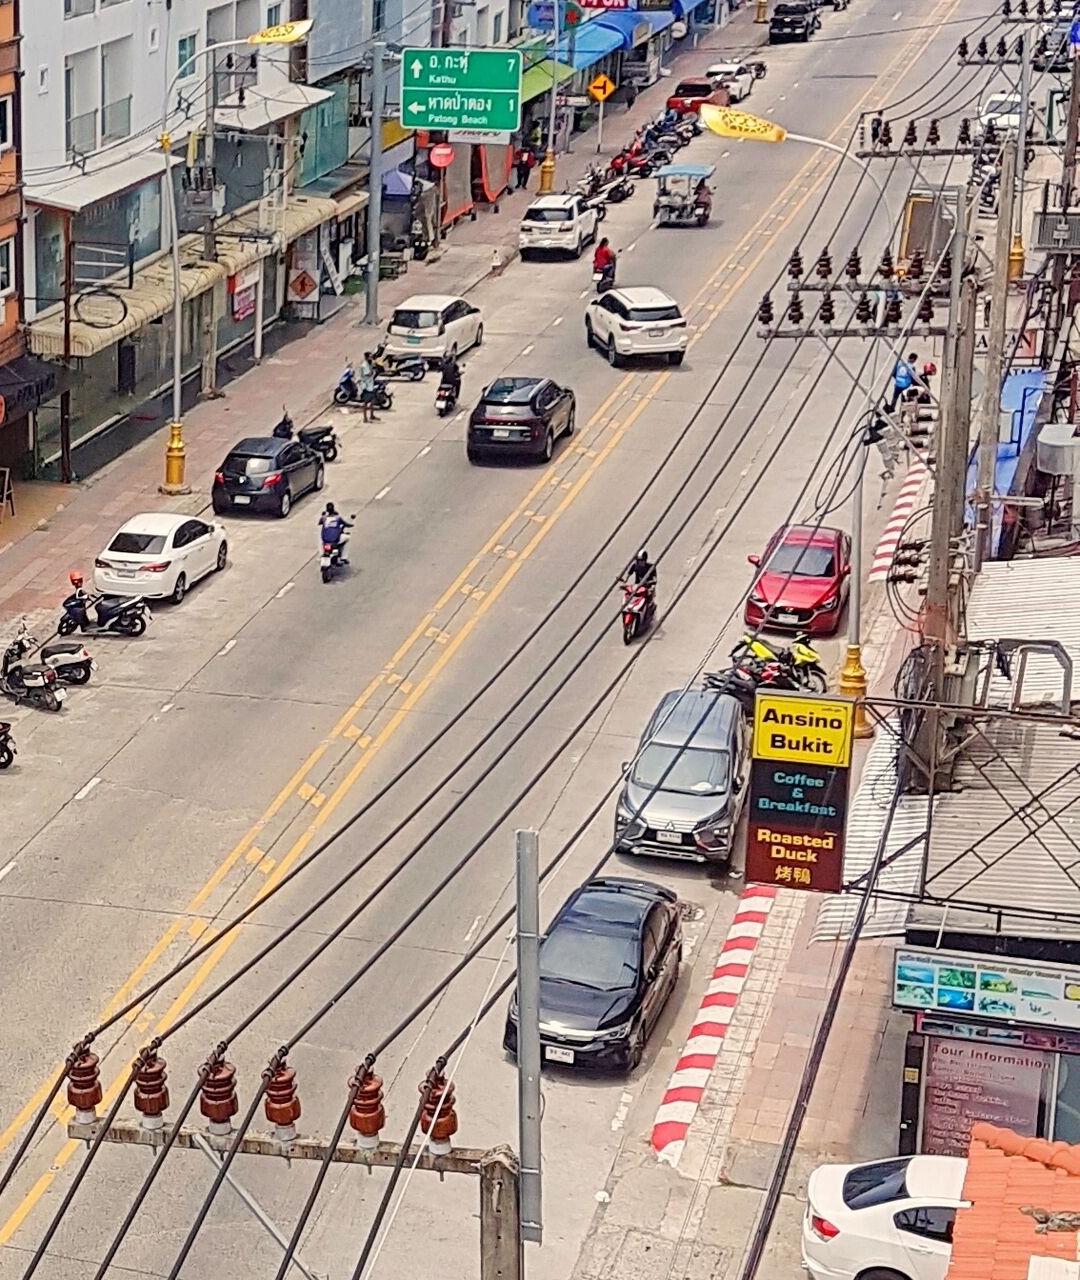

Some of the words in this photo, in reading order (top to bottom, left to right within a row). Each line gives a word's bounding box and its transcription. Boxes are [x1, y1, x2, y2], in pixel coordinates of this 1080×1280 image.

[507, 59, 516, 72] 7
[428, 74, 457, 84] Kathu
[428, 91, 492, 112] หาดป่าตอง
[508, 99, 515, 112] 1
[428, 114, 458, 125] Patong
[461, 115, 488, 125] Beach
[762, 708, 844, 730] Ansino
[770, 733, 834, 754] Bukit
[773, 771, 825, 788] Coffee
[791, 787, 804, 799] &
[758, 797, 837, 817] Breakfast
[757, 828, 835, 850] Roasted
[770, 845, 818, 863] Duck
[933, 1043, 964, 1057] Tour
[970, 1049, 1052, 1069] Information
